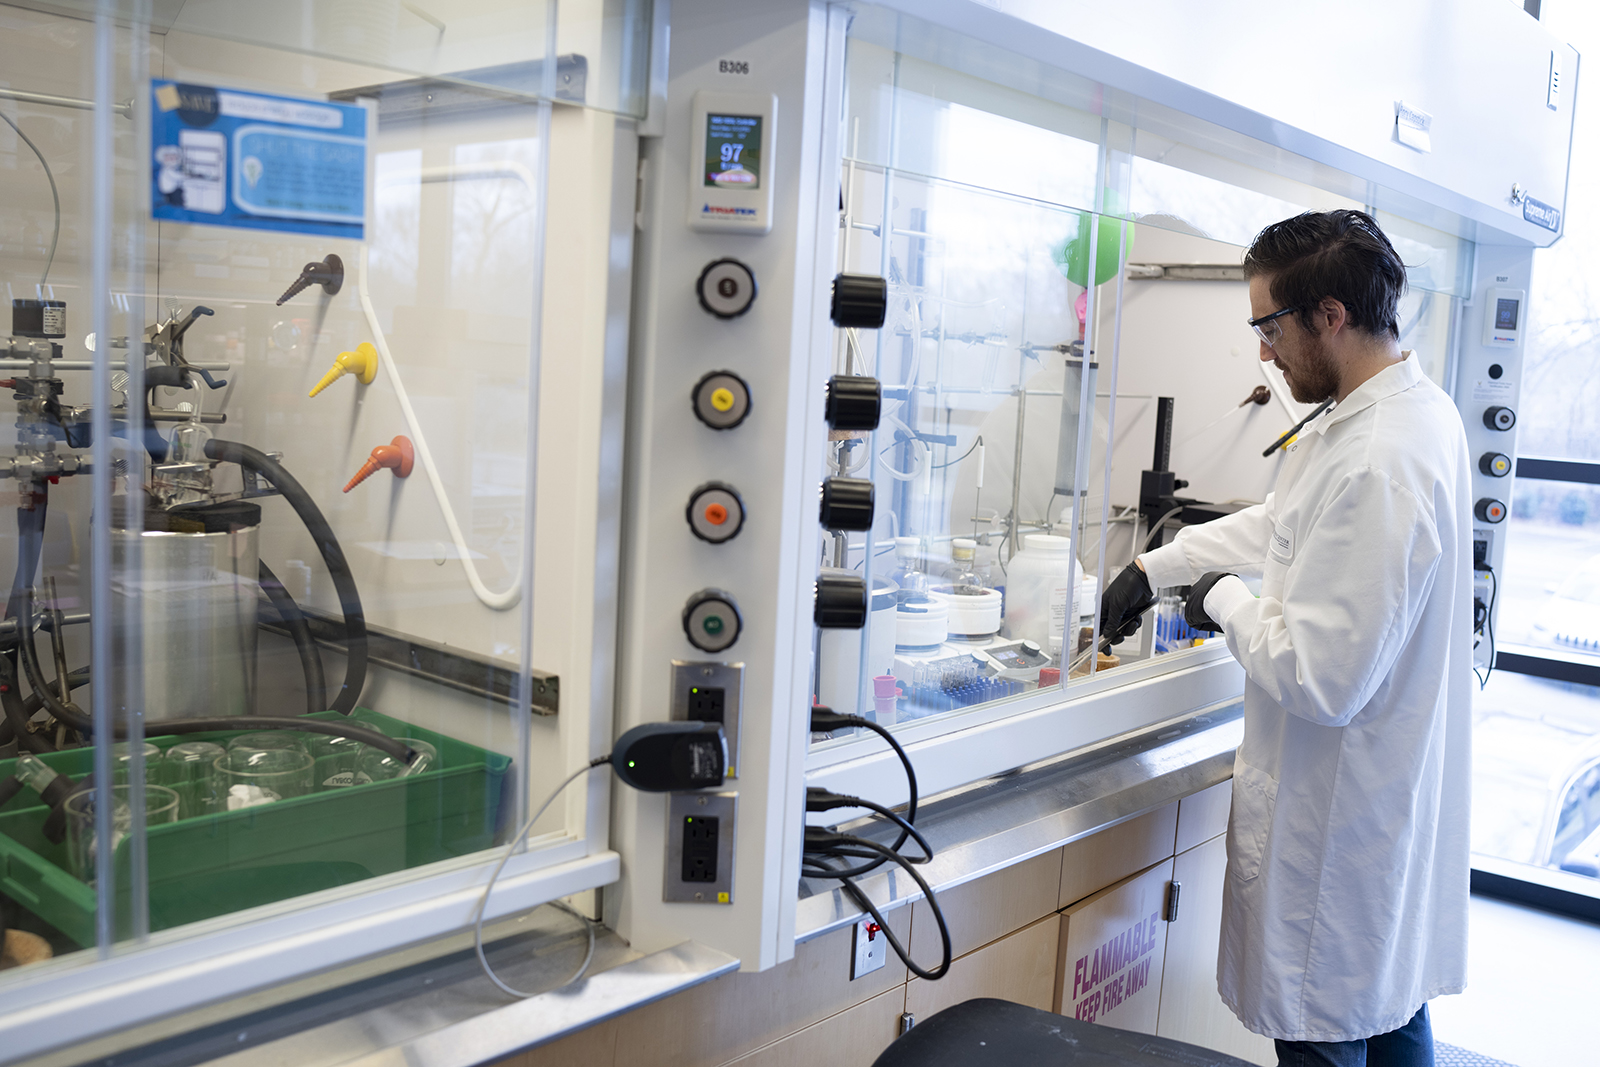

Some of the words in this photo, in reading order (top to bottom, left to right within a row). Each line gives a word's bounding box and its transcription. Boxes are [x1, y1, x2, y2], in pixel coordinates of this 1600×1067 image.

[719, 60, 749, 74] B306
[721, 142, 744, 162] 97
[1525, 199, 1545, 220] Supreme
[1072, 911, 1158, 1001] FLAMMABLE
[1075, 990, 1102, 1024] KEEP
[1102, 973, 1125, 1016] FIRE
[1124, 955, 1151, 1001] AWAY
